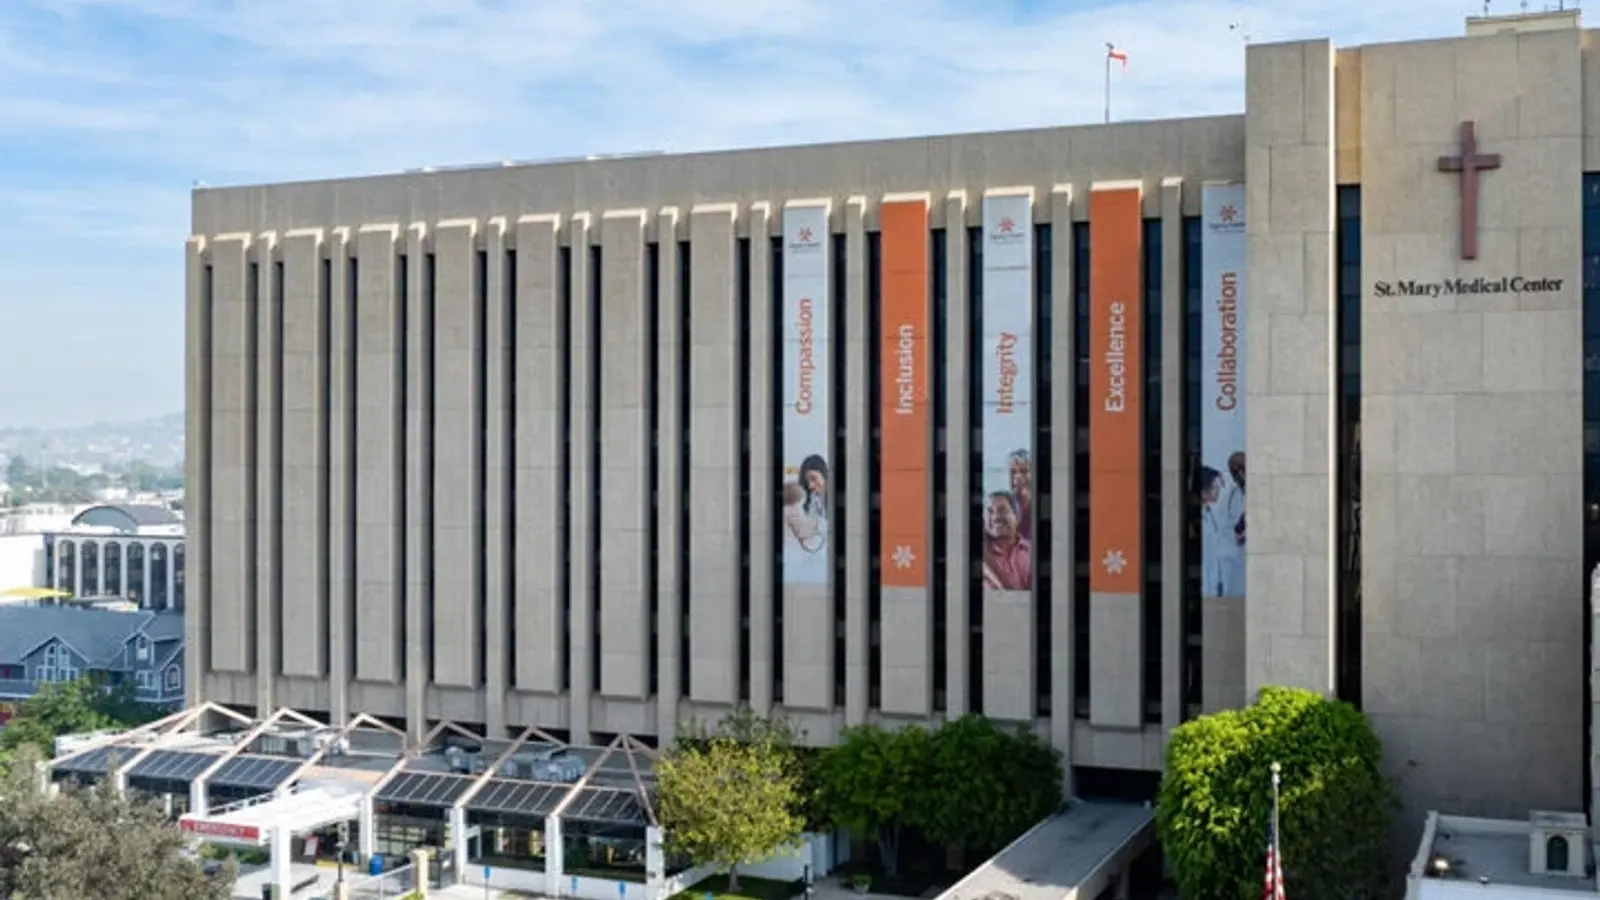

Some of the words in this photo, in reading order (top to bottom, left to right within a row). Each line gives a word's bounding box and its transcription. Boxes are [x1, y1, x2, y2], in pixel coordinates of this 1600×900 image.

[1374, 281, 1396, 298] St.
[1398, 281, 1440, 298] Mary
[1442, 277, 1507, 293] Medical
[1510, 276, 1564, 293] Center
[795, 298, 815, 415] Compassion
[895, 324, 914, 415] Inclusion
[996, 332, 1018, 414] Integrity
[1105, 302, 1125, 413] Excellence
[1216, 272, 1237, 411] Collaboration
